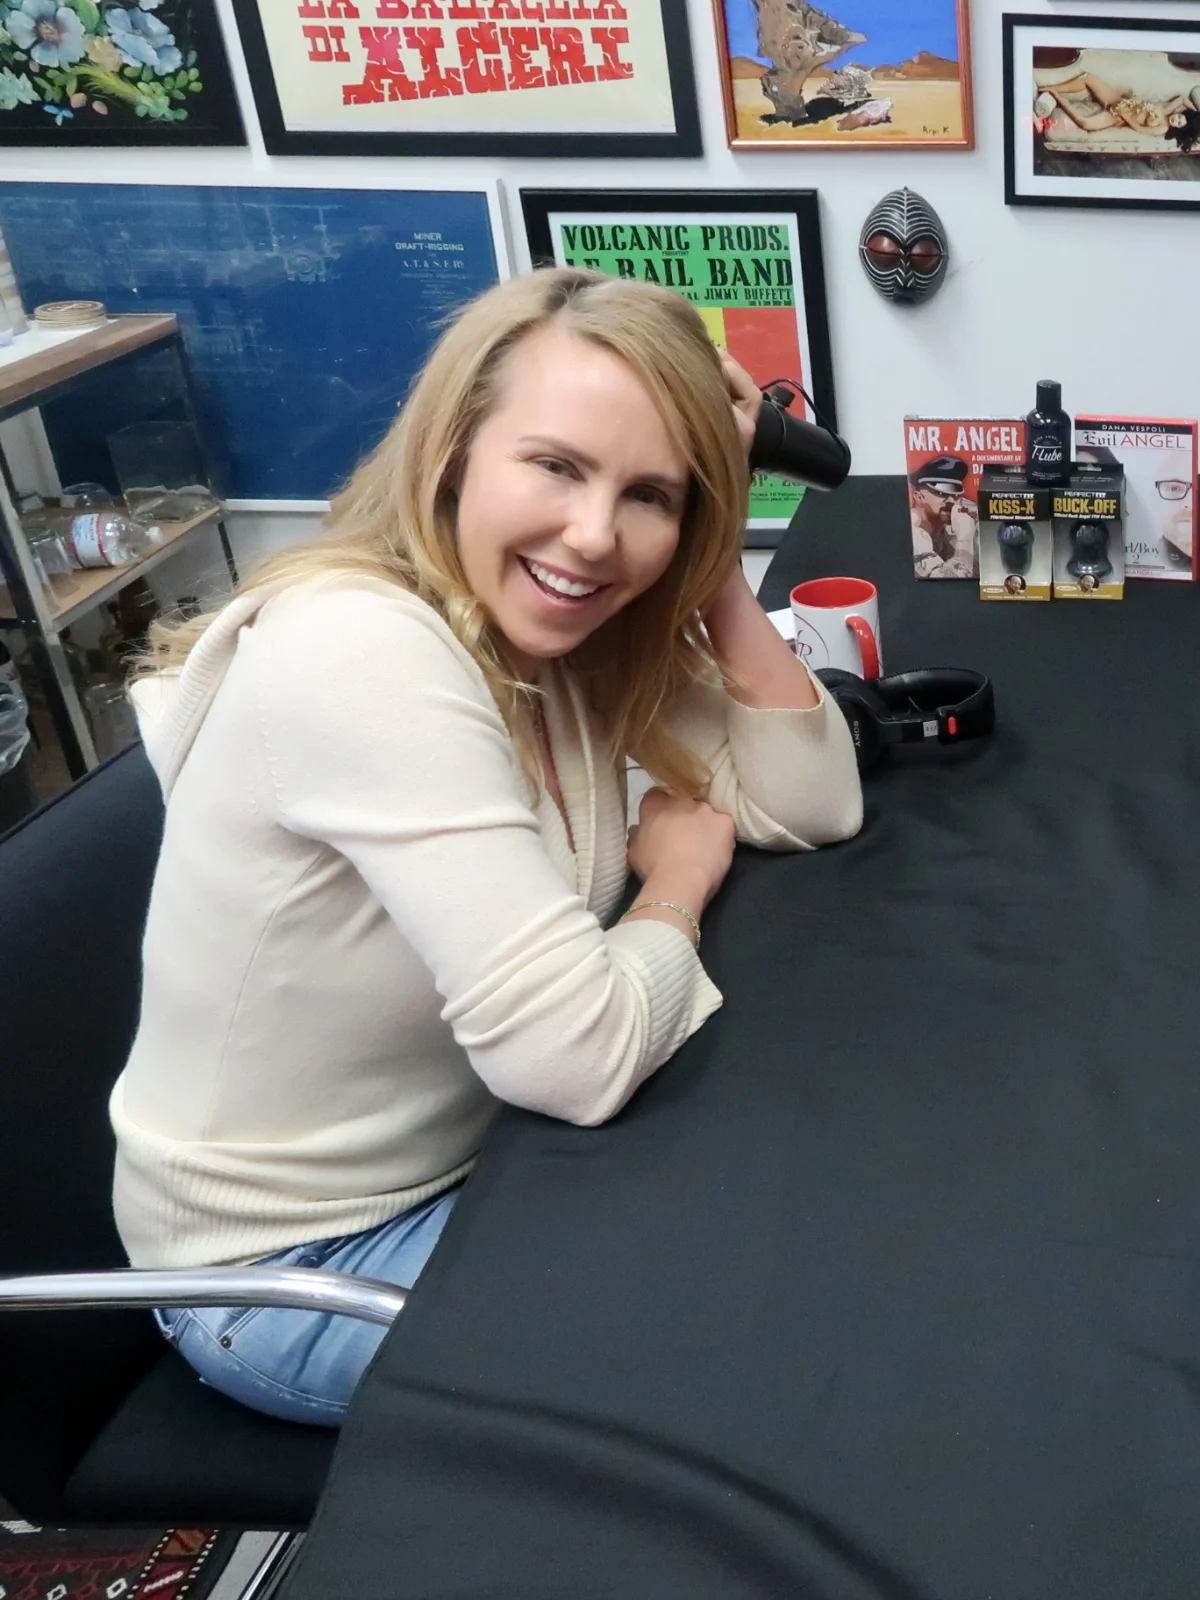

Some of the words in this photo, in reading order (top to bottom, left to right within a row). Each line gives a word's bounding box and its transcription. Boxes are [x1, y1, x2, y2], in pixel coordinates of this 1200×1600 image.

[302, 26, 351, 62] DI
[342, 22, 634, 105] ALGERI
[413, 232, 442, 240] MINER
[563, 225, 690, 251] VOLCANIC
[702, 225, 790, 251] PRODS.
[395, 242, 464, 251] DRAFT-RIGGING
[615, 258, 694, 286] RAIL
[707, 258, 793, 286] BAND
[704, 288, 739, 300] JIMMY
[744, 288, 792, 300] BUFFETT
[1130, 425, 1166, 433] VESPOLI
[908, 426, 949, 452] MR.
[954, 426, 1022, 452] ANGEL
[1083, 431, 1117, 446] Evil
[1120, 434, 1185, 449] ANGEL
[976, 454, 1013, 462] DOCUMENTARY
[989, 499, 1035, 515] KISS-X
[1053, 497, 1117, 514] BUCK-OFF
[1124, 542, 1159, 555] rl/Boy
[853, 720, 862, 747] SONY
